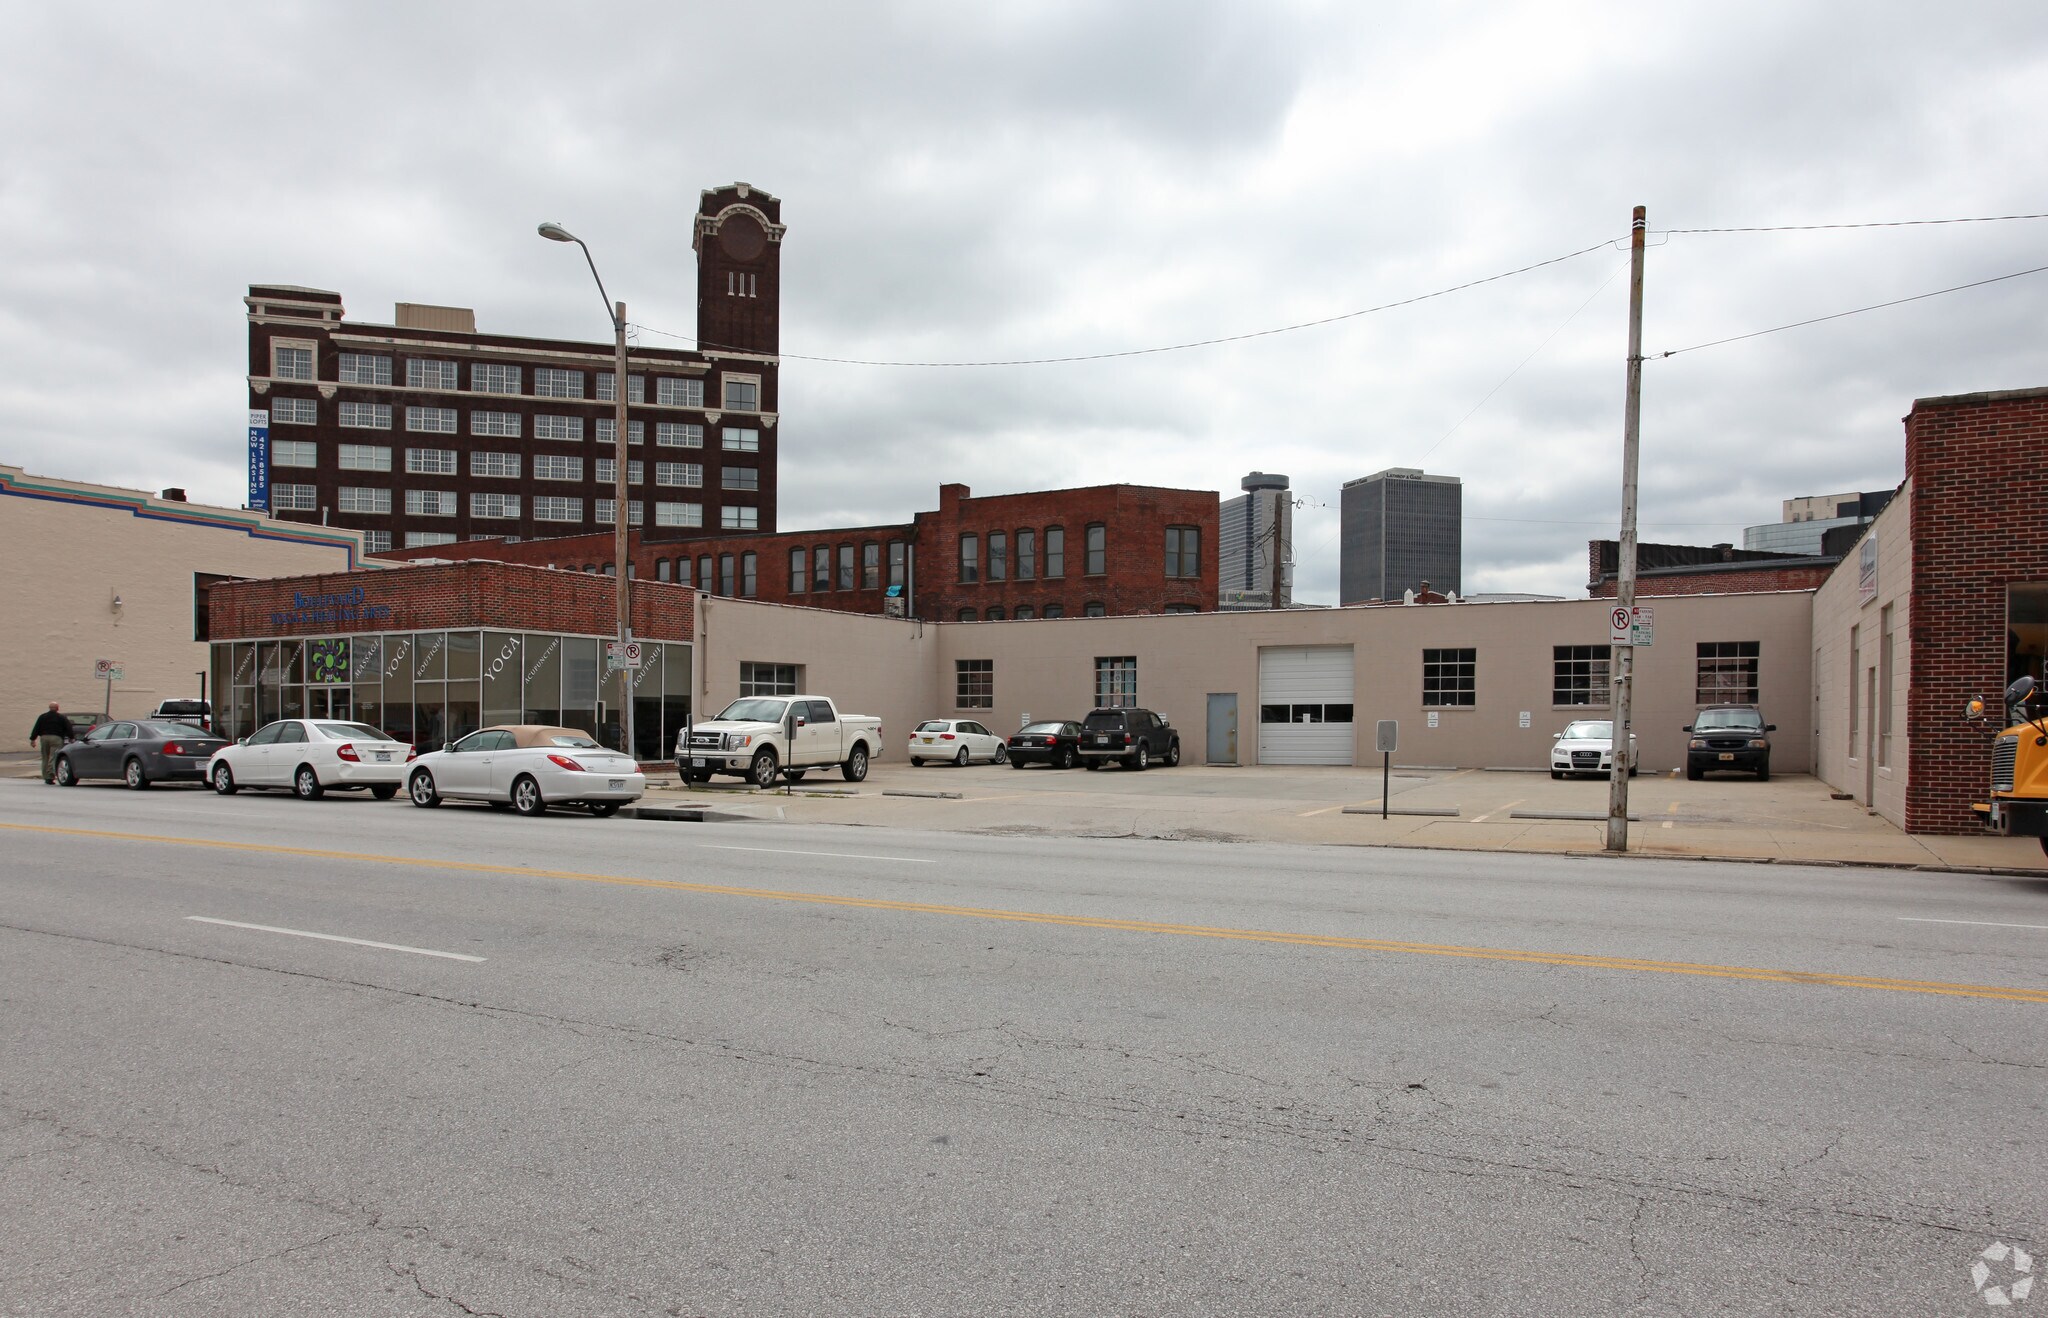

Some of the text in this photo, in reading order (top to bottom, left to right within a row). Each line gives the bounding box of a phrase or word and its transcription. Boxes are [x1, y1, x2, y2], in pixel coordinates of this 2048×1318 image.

[250, 430, 258, 494] NOW LEASING
[355, 638, 380, 679] MASSAGE
[385, 639, 411, 679] YOGA
[417, 635, 444, 677] BOUTIQUE
[484, 636, 520, 681] YOGA
[525, 638, 560, 684] ACUPUNCTURE
[633, 645, 662, 688] BOUTIQUE
